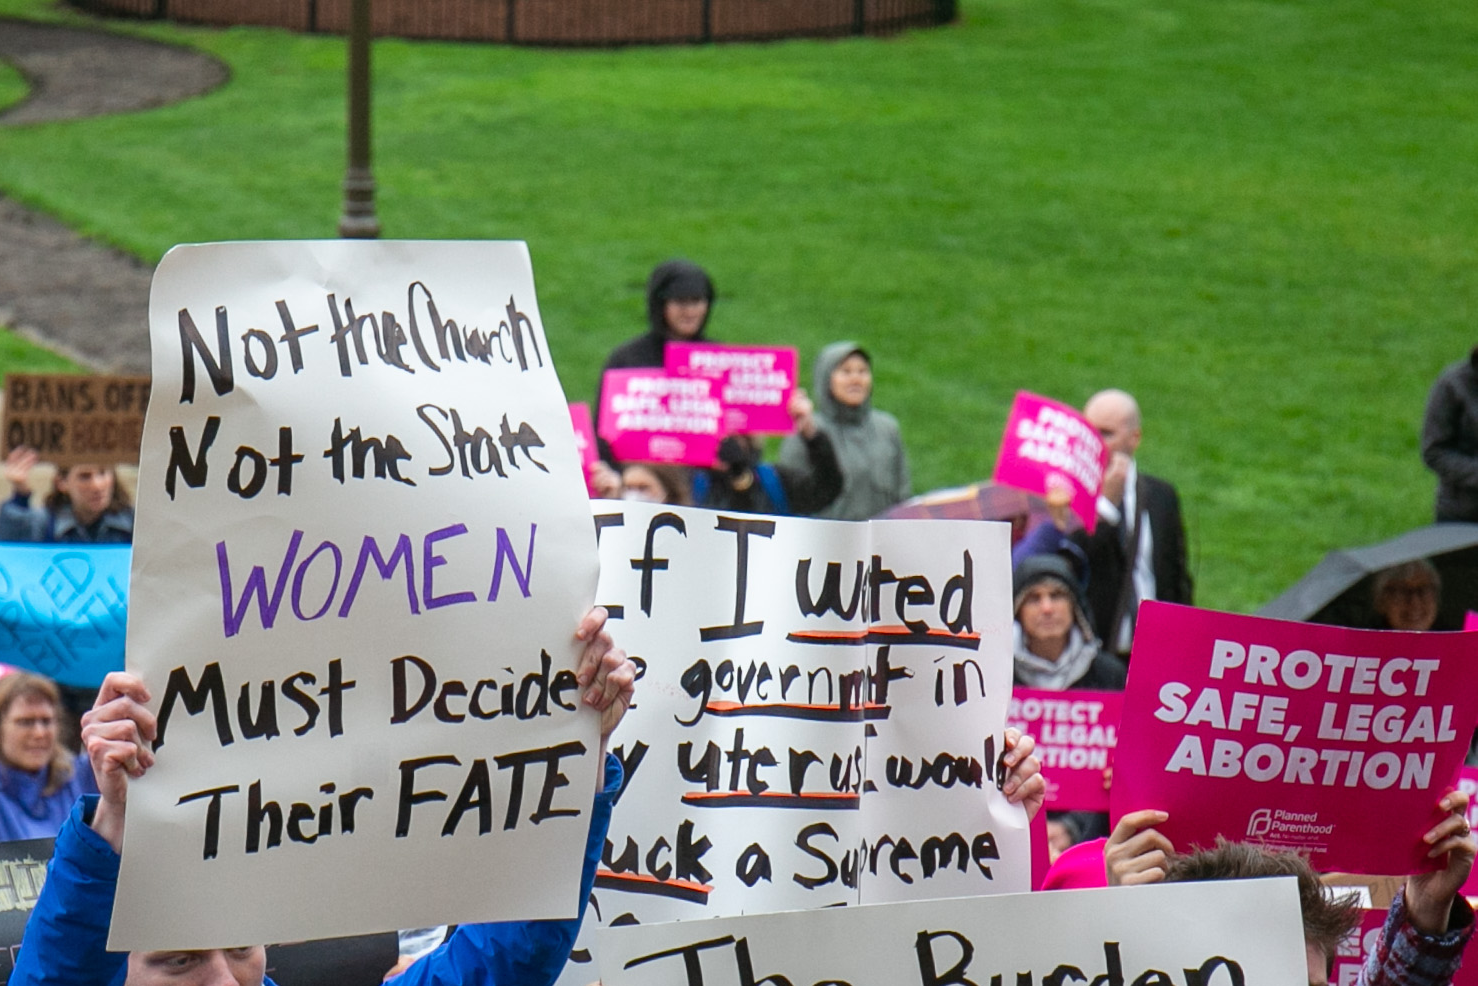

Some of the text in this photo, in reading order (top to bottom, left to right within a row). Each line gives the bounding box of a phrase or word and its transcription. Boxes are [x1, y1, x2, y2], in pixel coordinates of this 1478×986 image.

[178, 281, 543, 404] Not the Church
[10, 377, 96, 413] BANS
[7, 420, 66, 452] OUR
[165, 416, 305, 501] Not
[323, 417, 417, 486] the
[417, 404, 550, 478] State
[216, 522, 538, 638] WOMEN
[699, 515, 776, 642] I
[933, 655, 986, 706] in
[1209, 638, 1441, 697] PROTECT
[151, 657, 356, 754] Must
[390, 647, 580, 725] Decide
[1153, 681, 1457, 744] SAFE, LEGAL
[1041, 722, 1118, 748] LEGAL
[1164, 734, 1436, 790] ABORTION
[612, 739, 649, 807] y
[677, 728, 863, 796] uterus
[176, 740, 587, 860] Their FATE
[1271, 820, 1333, 835] Parenthood
[1274, 809, 1319, 823] Planned
[600, 819, 714, 885] uck
[736, 843, 773, 888] a
